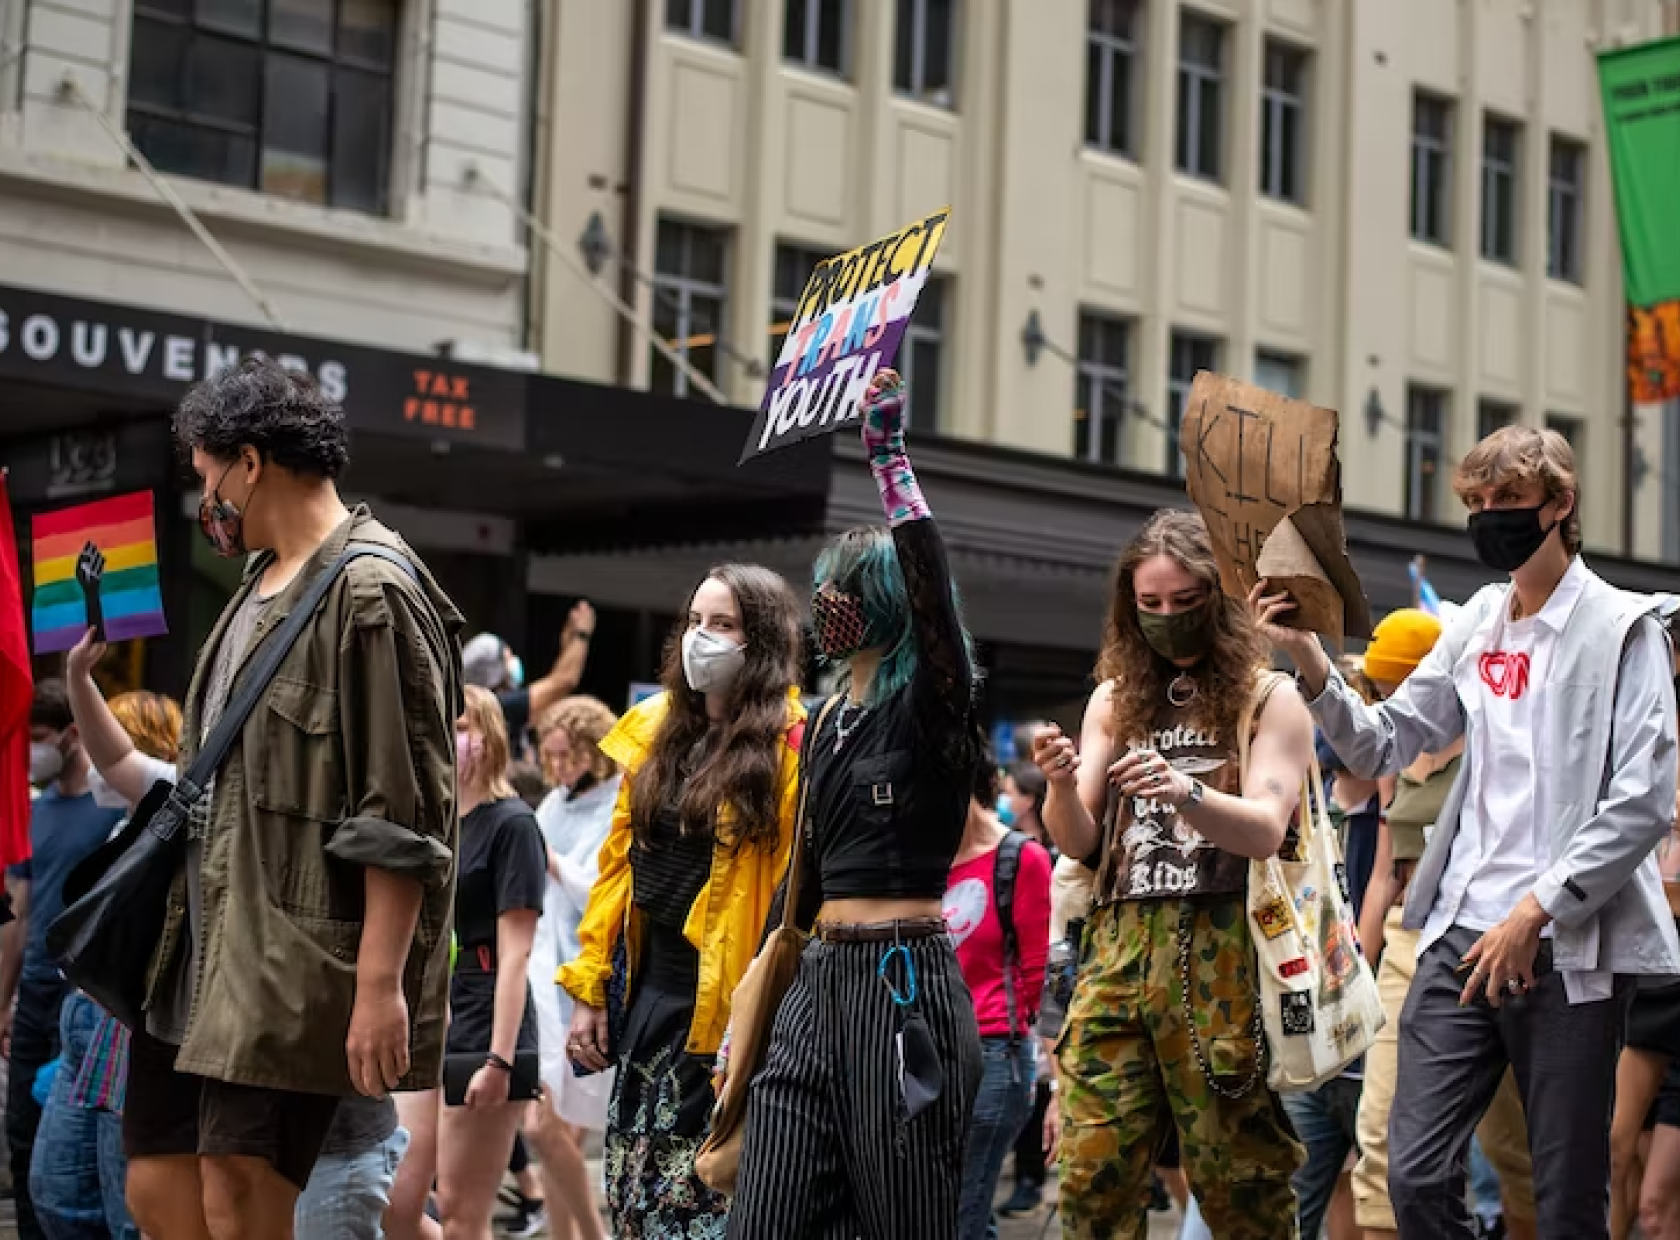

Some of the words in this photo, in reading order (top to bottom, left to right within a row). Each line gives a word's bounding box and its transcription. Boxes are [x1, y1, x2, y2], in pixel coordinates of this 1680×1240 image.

[790, 212, 948, 336] PROTECT
[0, 307, 347, 402] OUVENS
[783, 281, 900, 386] TRANS
[405, 400, 477, 430] FREE
[413, 370, 469, 400] TAX
[758, 351, 881, 450] YOUTH
